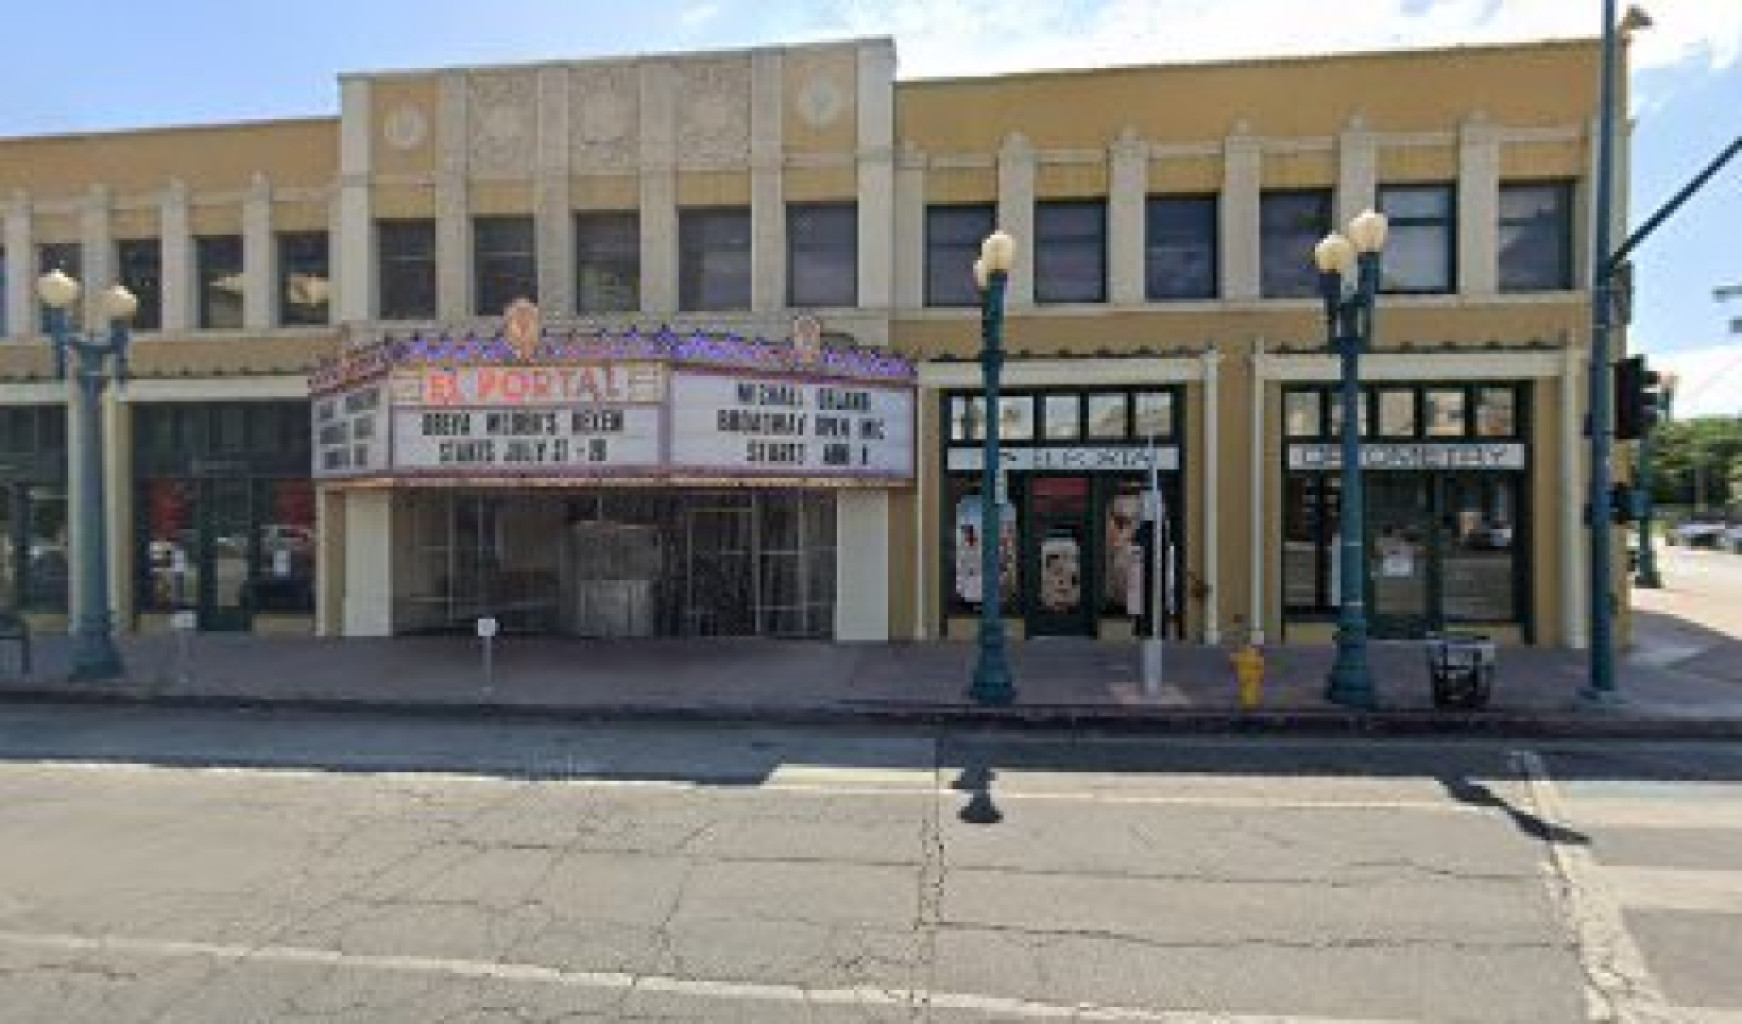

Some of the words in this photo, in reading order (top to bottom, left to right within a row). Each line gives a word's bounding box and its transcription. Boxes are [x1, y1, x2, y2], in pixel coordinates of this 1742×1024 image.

[478, 366, 628, 403] PORTAL
[439, 438, 496, 462] STARTS
[502, 438, 547, 462] JULY
